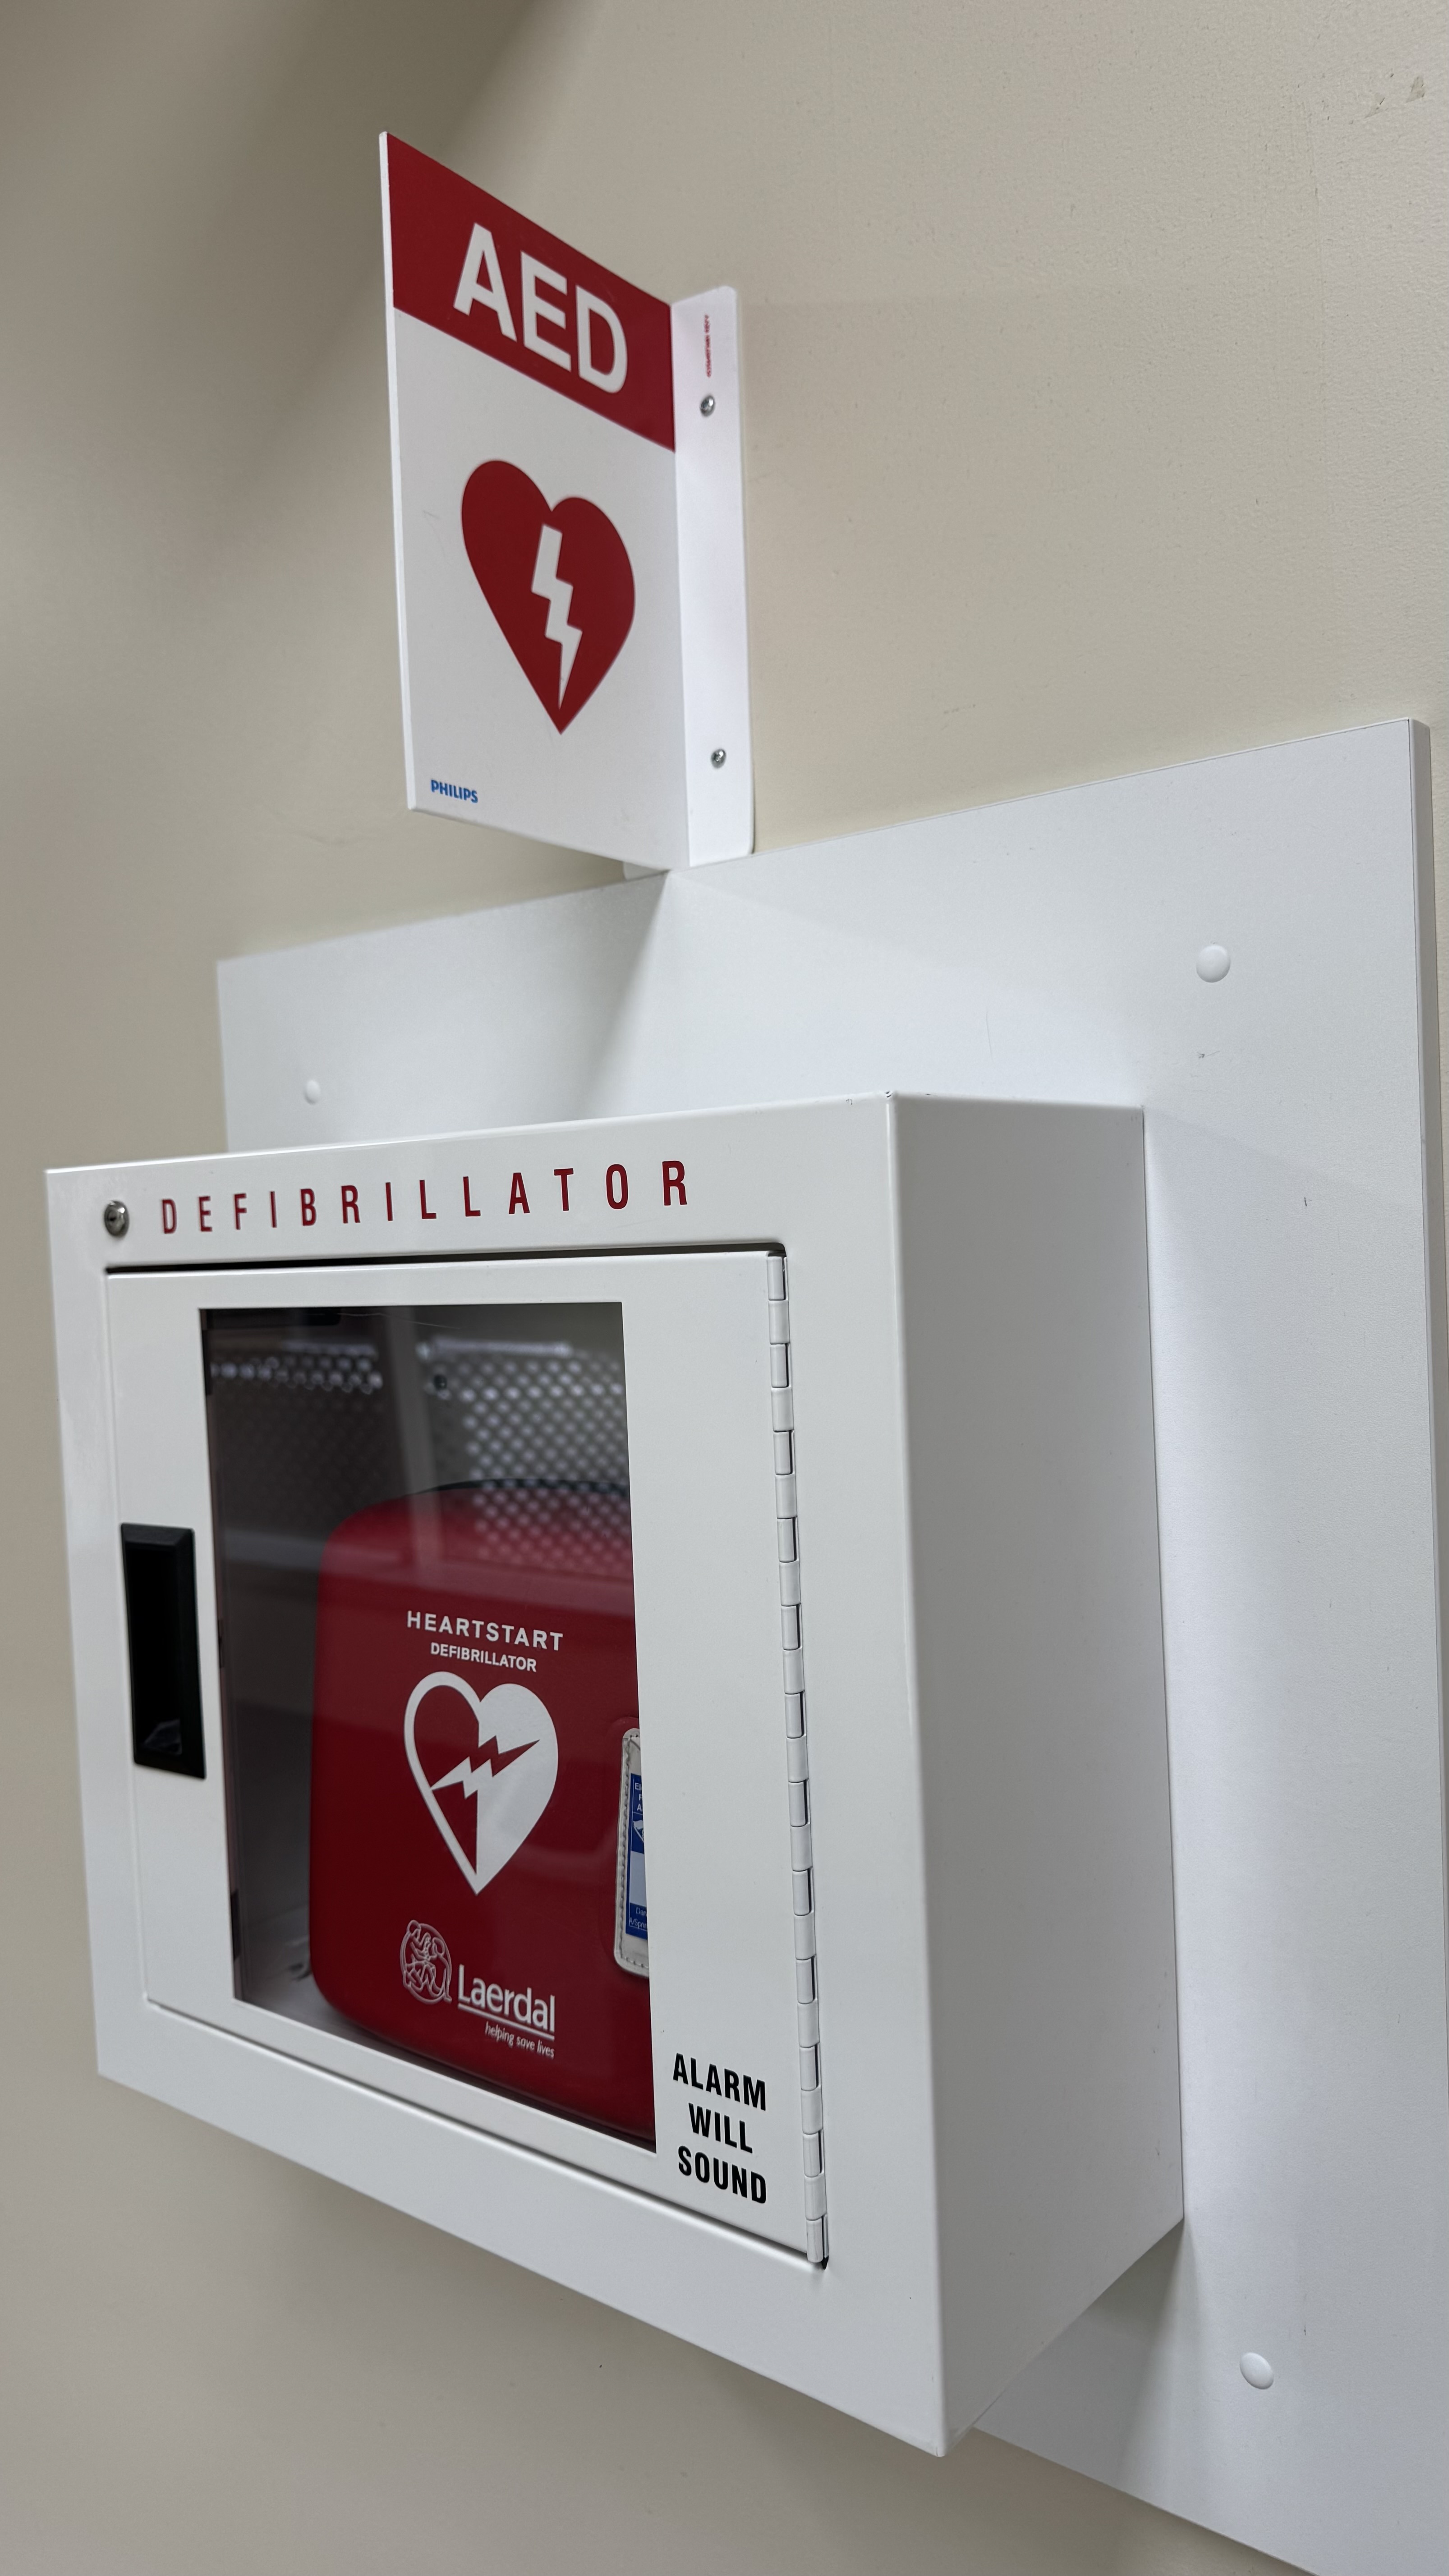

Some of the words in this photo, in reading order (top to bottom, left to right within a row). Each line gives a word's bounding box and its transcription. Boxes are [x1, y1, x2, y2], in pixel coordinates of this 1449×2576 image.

[454, 222, 627, 394] AED
[431, 779, 478, 803] PHILIPS
[161, 1160, 688, 1235] DEFIBRILLATOR
[407, 1610, 563, 1651] HEARTSTART
[431, 1642, 537, 1672] DEFIBRILLATOR
[458, 1964, 555, 2033] Laerdal
[484, 2021, 515, 2048] helping
[516, 2036, 535, 2052] save
[537, 2039, 555, 2060] lives
[673, 2052, 766, 2111] ALARM
[688, 2102, 753, 2154] WILL
[678, 2145, 767, 2204] SOUND
